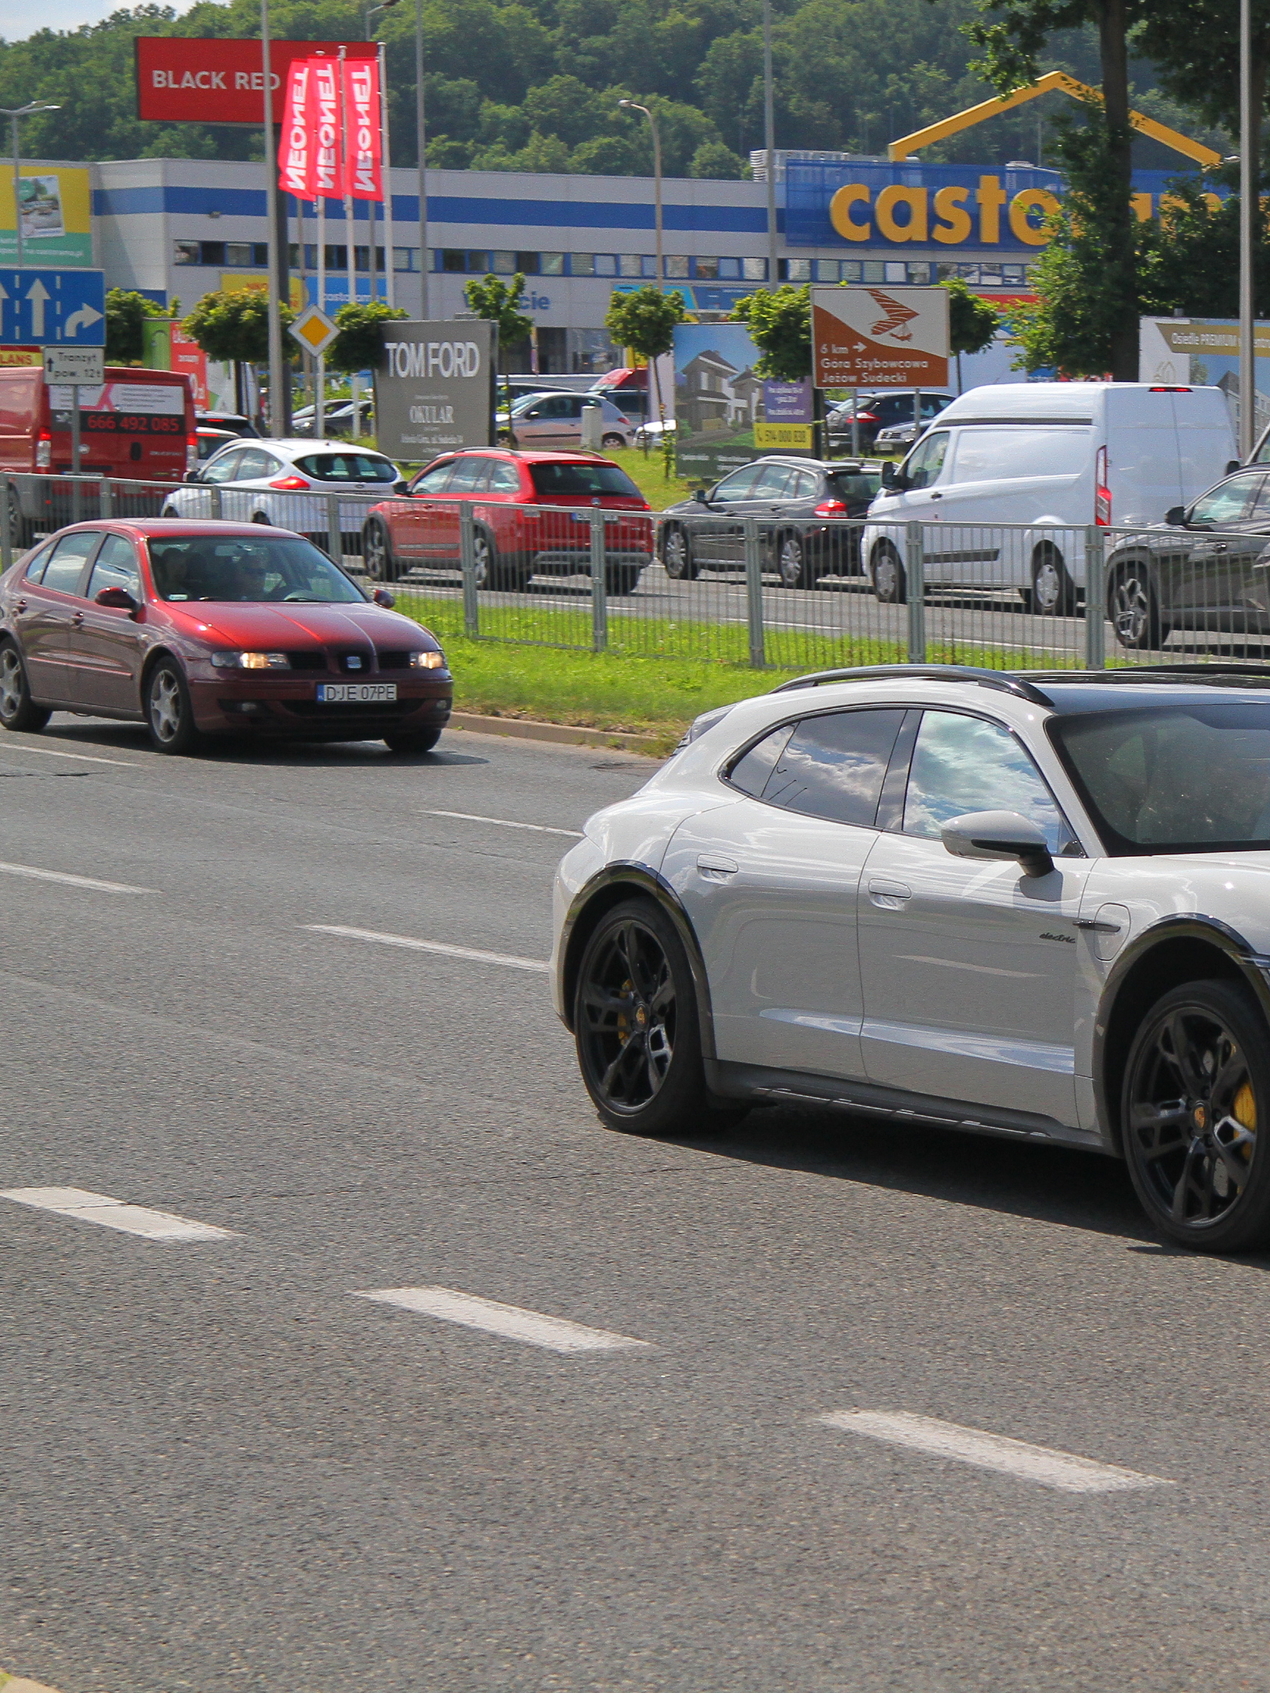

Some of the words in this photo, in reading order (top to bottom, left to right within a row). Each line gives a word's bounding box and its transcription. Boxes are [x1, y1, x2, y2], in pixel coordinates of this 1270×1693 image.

[152, 69, 228, 90] BLACK
[234, 71, 281, 91] RED
[1171, 332, 1200, 346] Osiedle
[1200, 333, 1238, 347] PREMIUM
[820, 343, 828, 354] 6
[831, 343, 849, 354] km
[57, 351, 97, 365] Tranzyt
[384, 341, 426, 378] TOM
[427, 341, 480, 378] FORD
[820, 357, 851, 369] Góra
[855, 357, 929, 371] Szybowcowa
[861, 371, 907, 383] Sudecki
[409, 405, 455, 423] OKULAR
[87, 414, 116, 430] 666
[120, 416, 148, 431] 492
[151, 417, 179, 432] 085
[326, 686, 357, 700] DJE
[361, 686, 395, 700] 07PE
